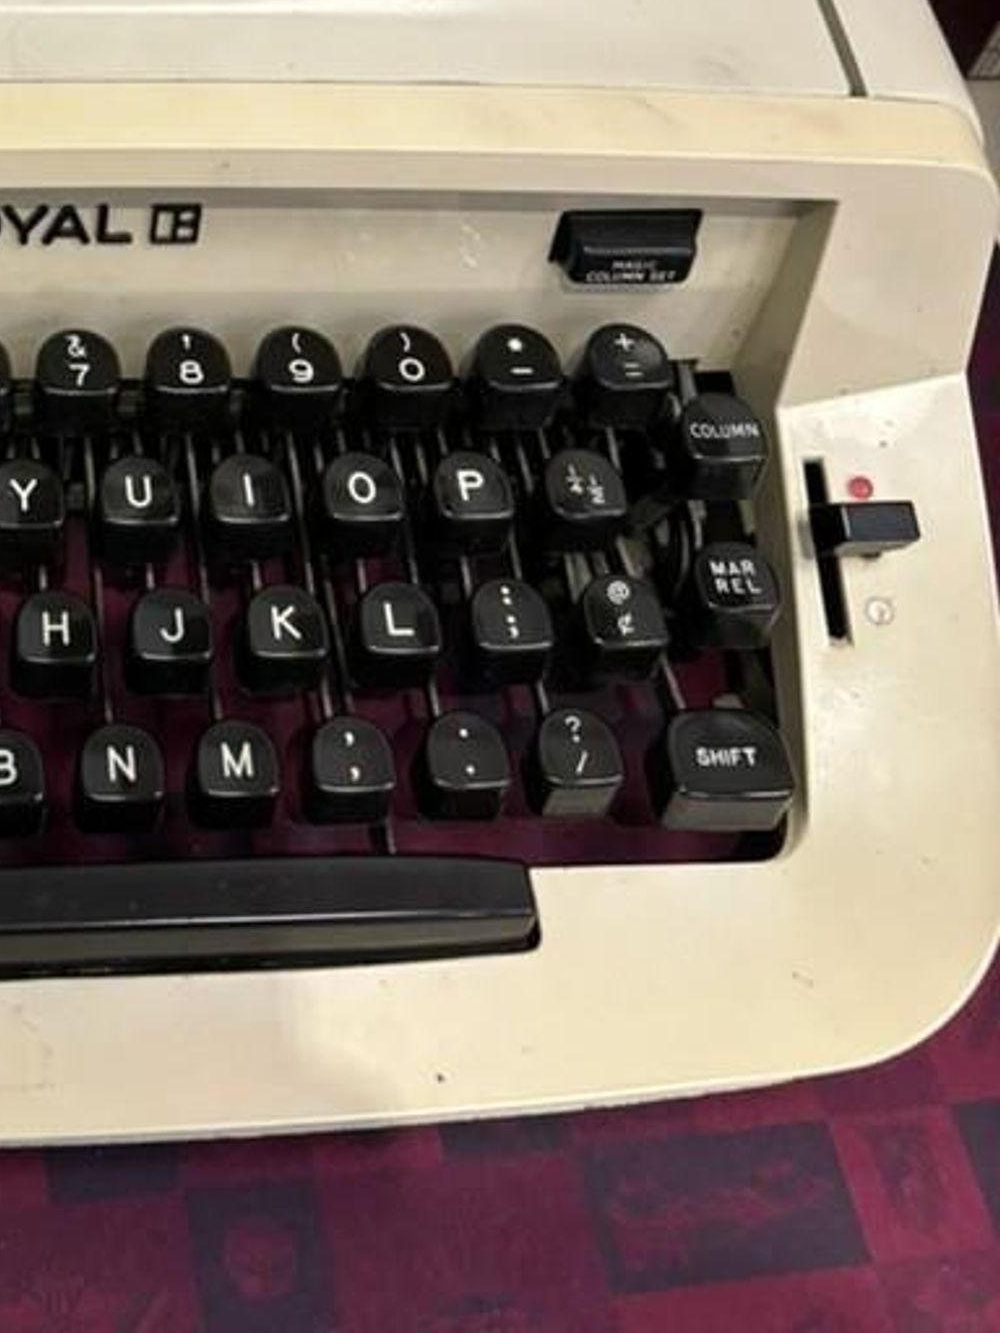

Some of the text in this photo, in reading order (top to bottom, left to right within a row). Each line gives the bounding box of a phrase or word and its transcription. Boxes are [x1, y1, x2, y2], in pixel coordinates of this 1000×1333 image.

[67, 334, 86, 358] &
[69, 363, 90, 386] 7
[179, 360, 204, 384] 8
[288, 359, 314, 383] 9
[398, 357, 425, 382] 0
[690, 423, 760, 439] COLUMN
[9, 478, 37, 511] Y
[125, 476, 152, 508] U
[347, 471, 377, 504] O
[456, 470, 484, 501] P
[710, 559, 755, 575] MAR
[715, 577, 762, 594] REL
[42, 611, 70, 646] H
[160, 608, 184, 643] J
[271, 605, 301, 640] K
[384, 602, 415, 636] L
[564, 715, 581, 743] ?
[107, 746, 136, 781] N
[221, 742, 253, 777] M
[696, 747, 756, 766] SHIFT
